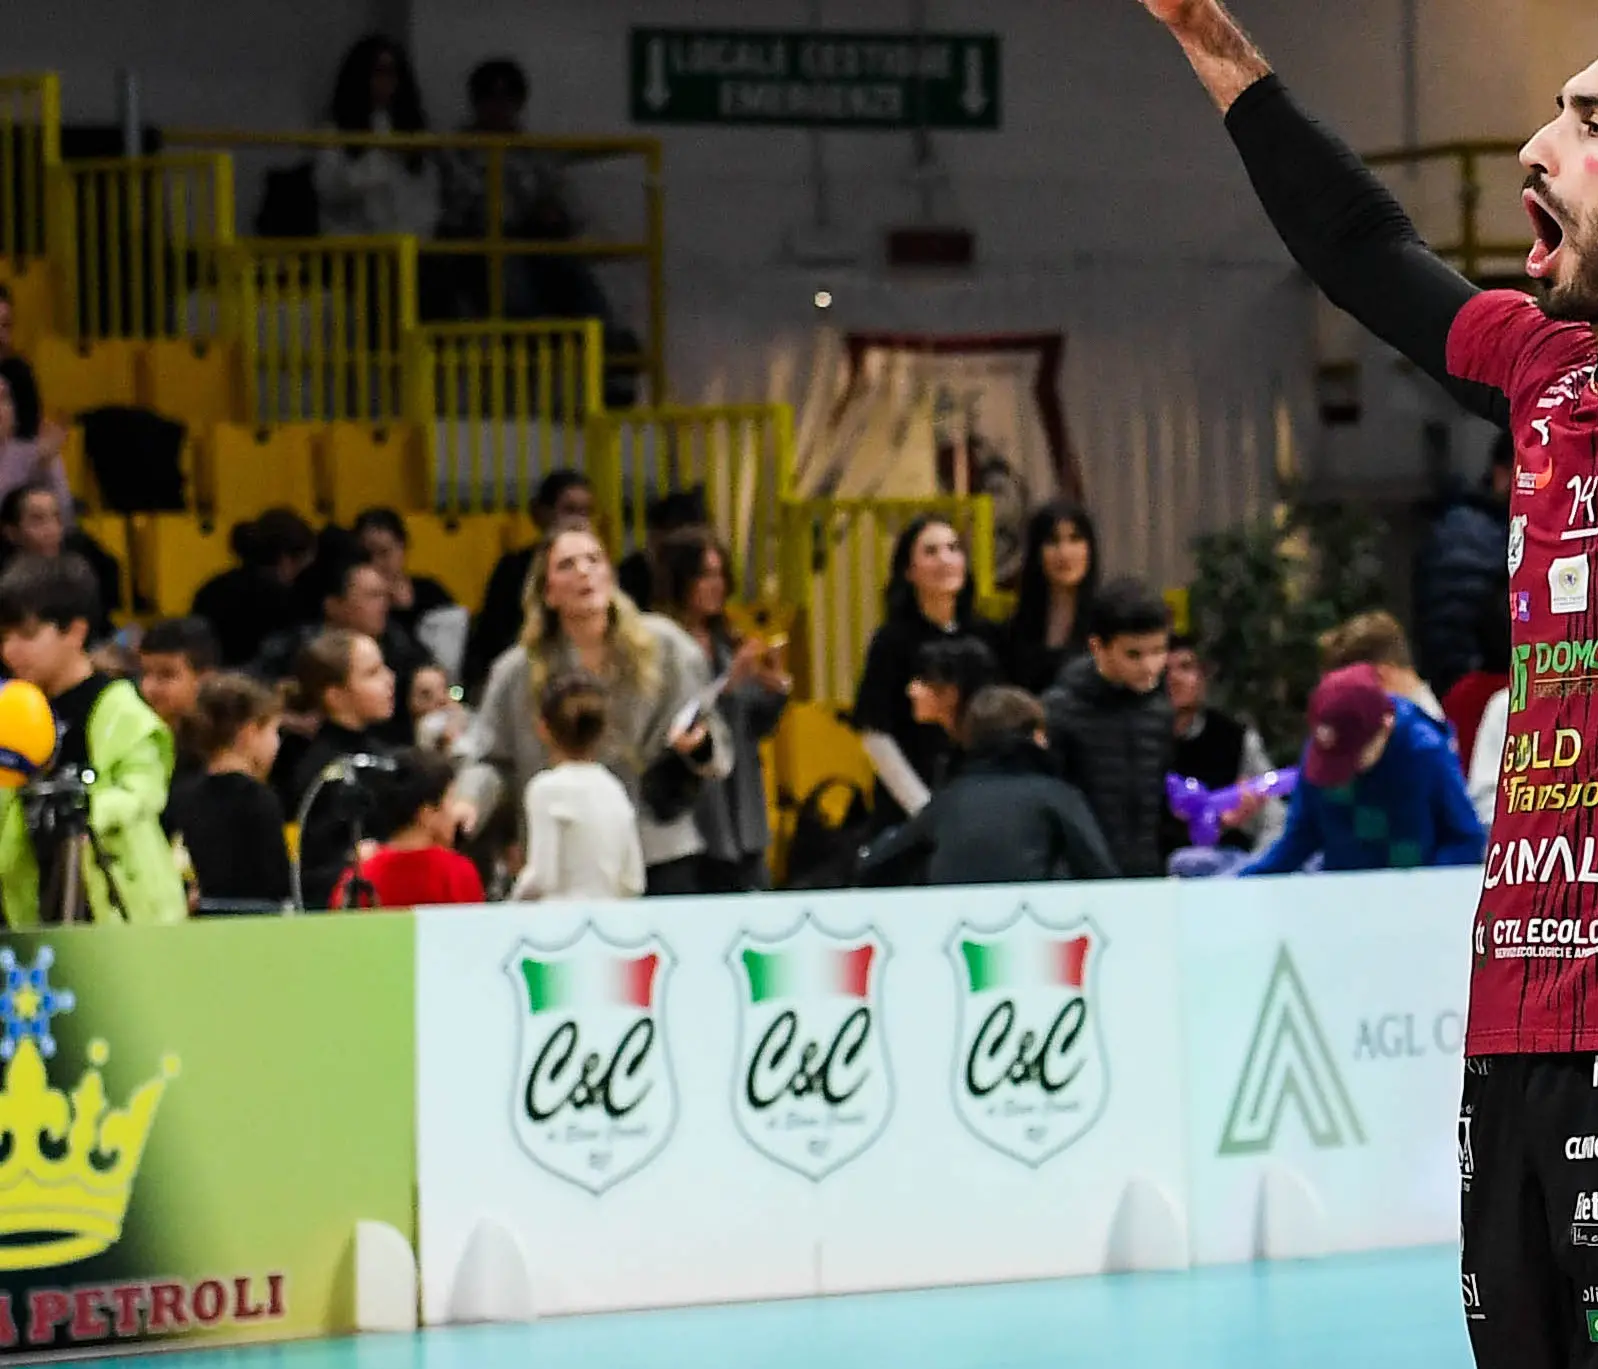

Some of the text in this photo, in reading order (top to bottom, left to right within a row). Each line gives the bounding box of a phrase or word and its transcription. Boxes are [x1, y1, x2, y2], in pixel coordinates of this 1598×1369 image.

[1493, 919, 1523, 945] CTL
[525, 1016, 655, 1121] C&C
[746, 1006, 872, 1109] C&C
[965, 997, 1088, 1097] C&C
[1354, 1012, 1428, 1060] AGL
[28, 1273, 285, 1345] PETROLI
